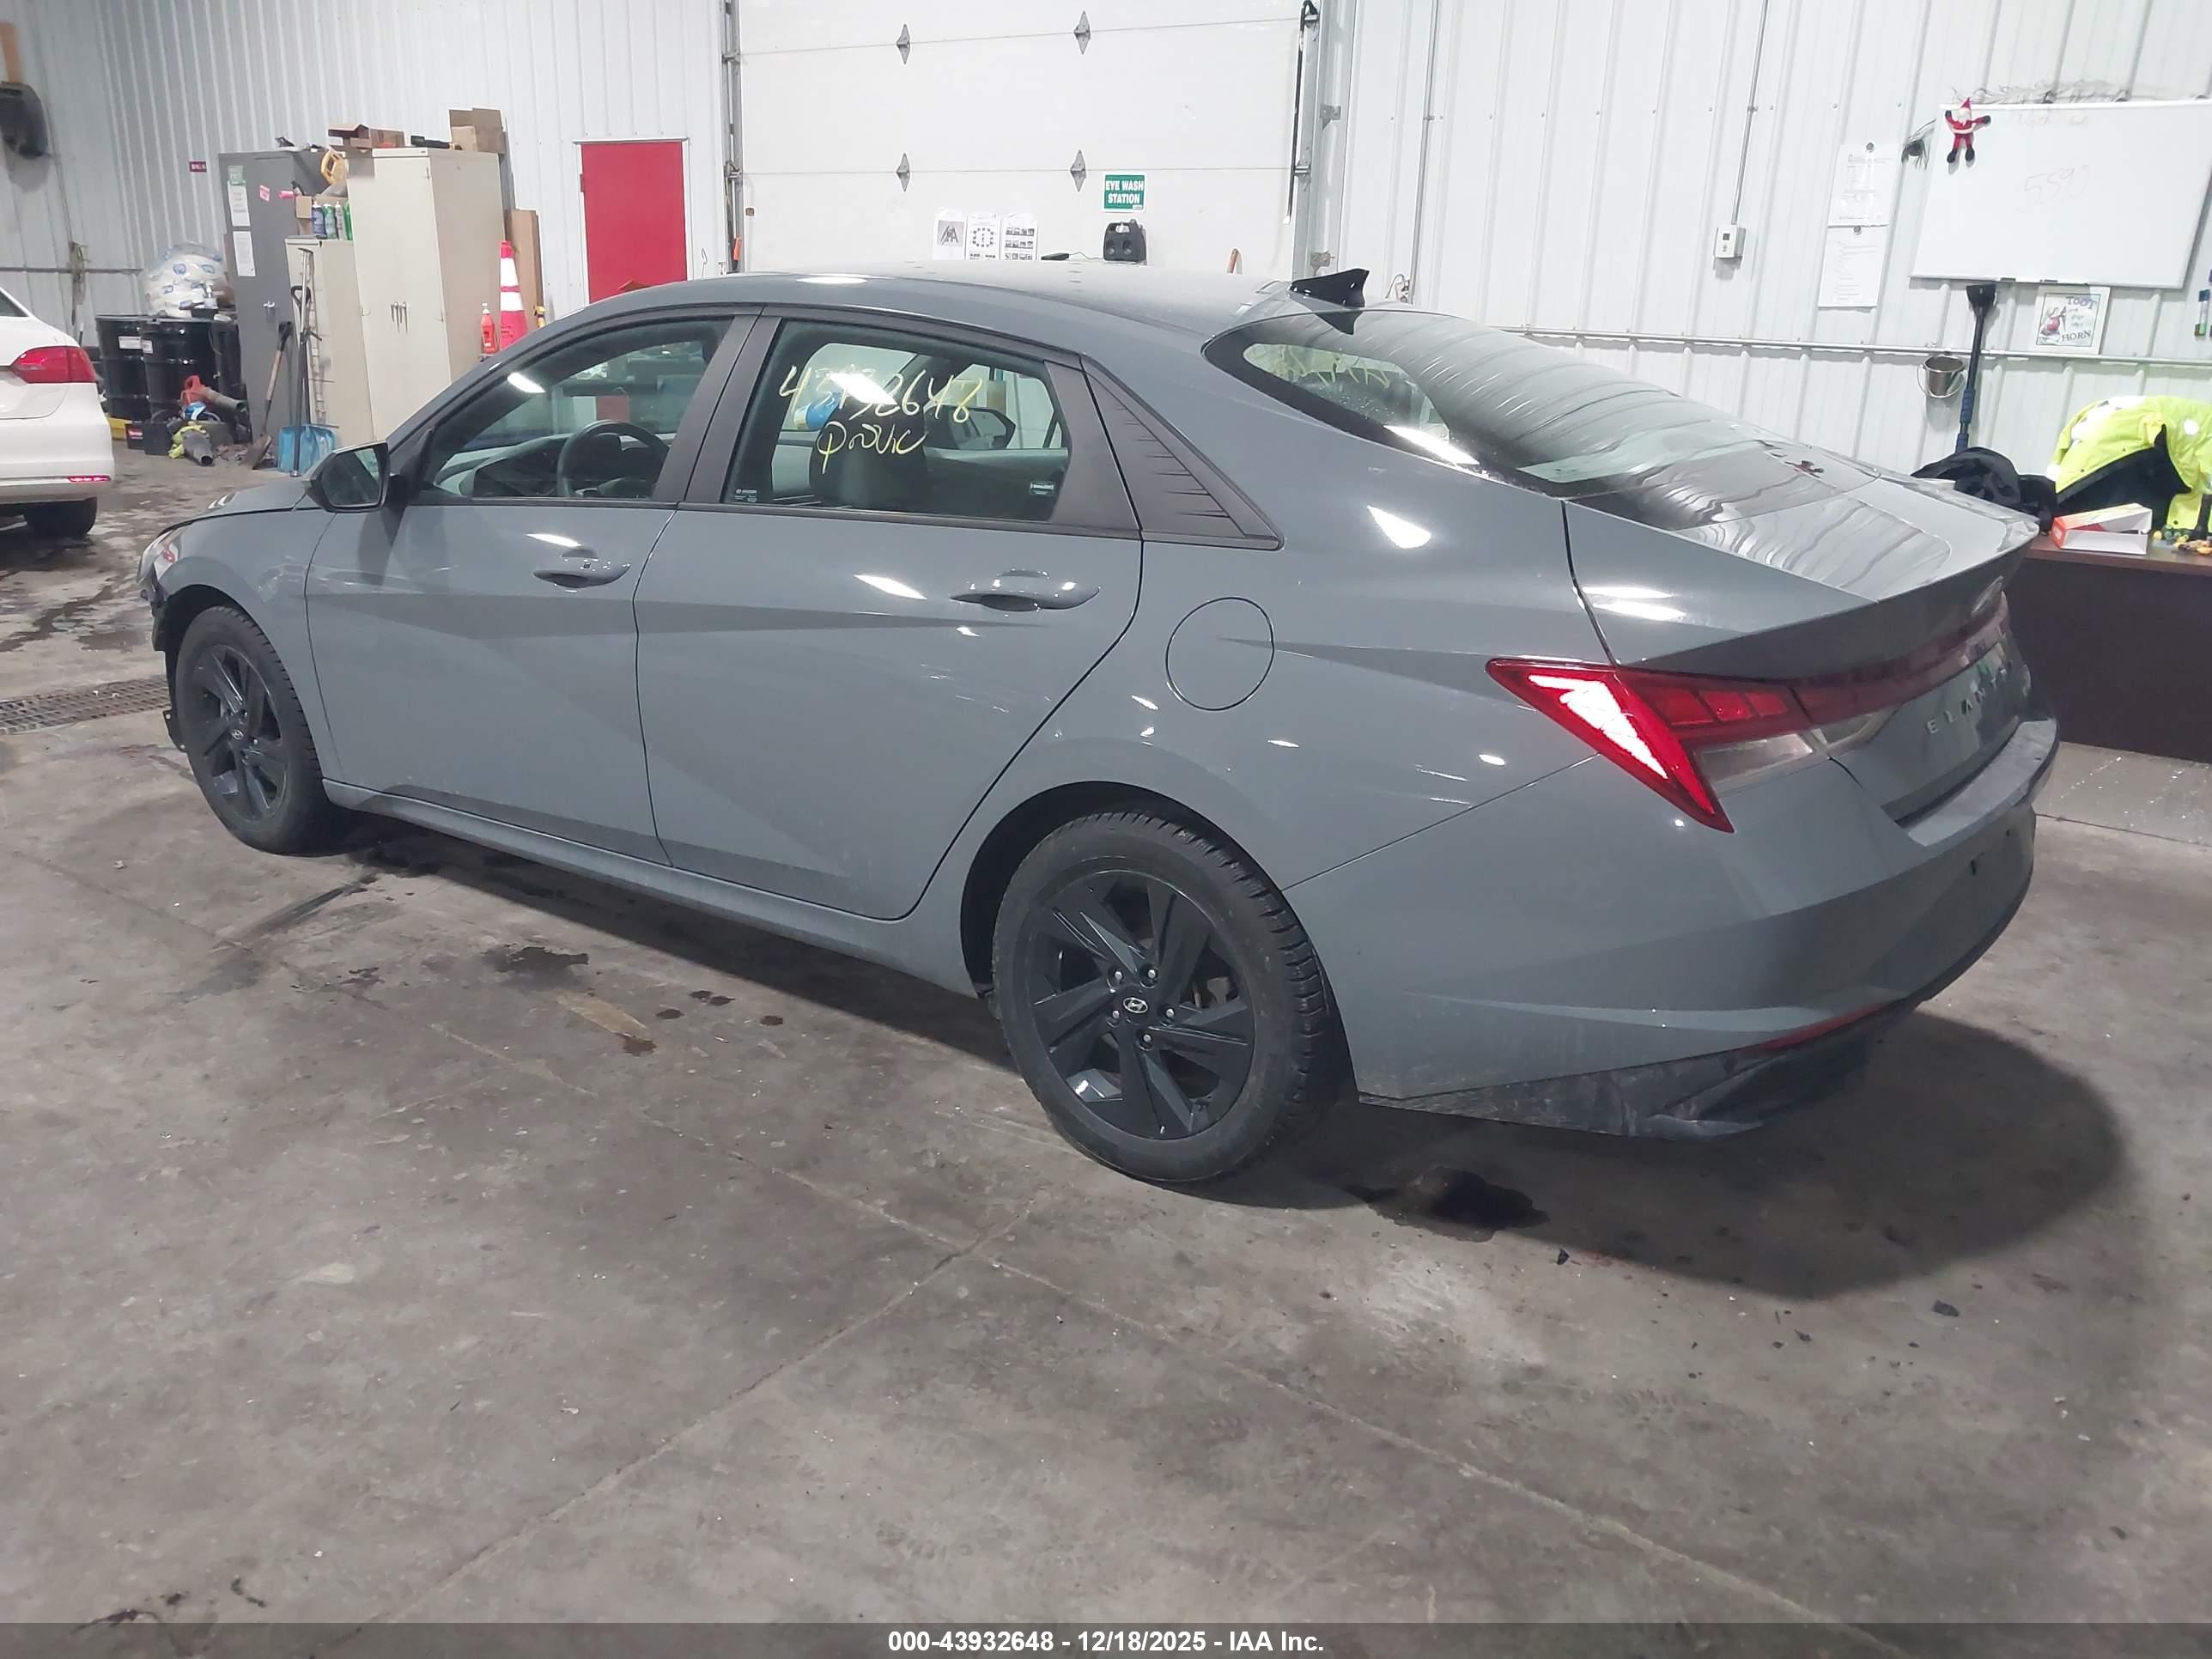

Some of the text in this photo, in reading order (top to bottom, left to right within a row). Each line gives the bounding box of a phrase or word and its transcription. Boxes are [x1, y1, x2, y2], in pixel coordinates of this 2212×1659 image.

[1105, 180, 1144, 191] EYE WASH
[1108, 193, 1140, 204] STATION
[2066, 296, 2097, 309] TOOT
[2062, 330, 2091, 342] HORN
[1926, 659, 2013, 734] ELANT
